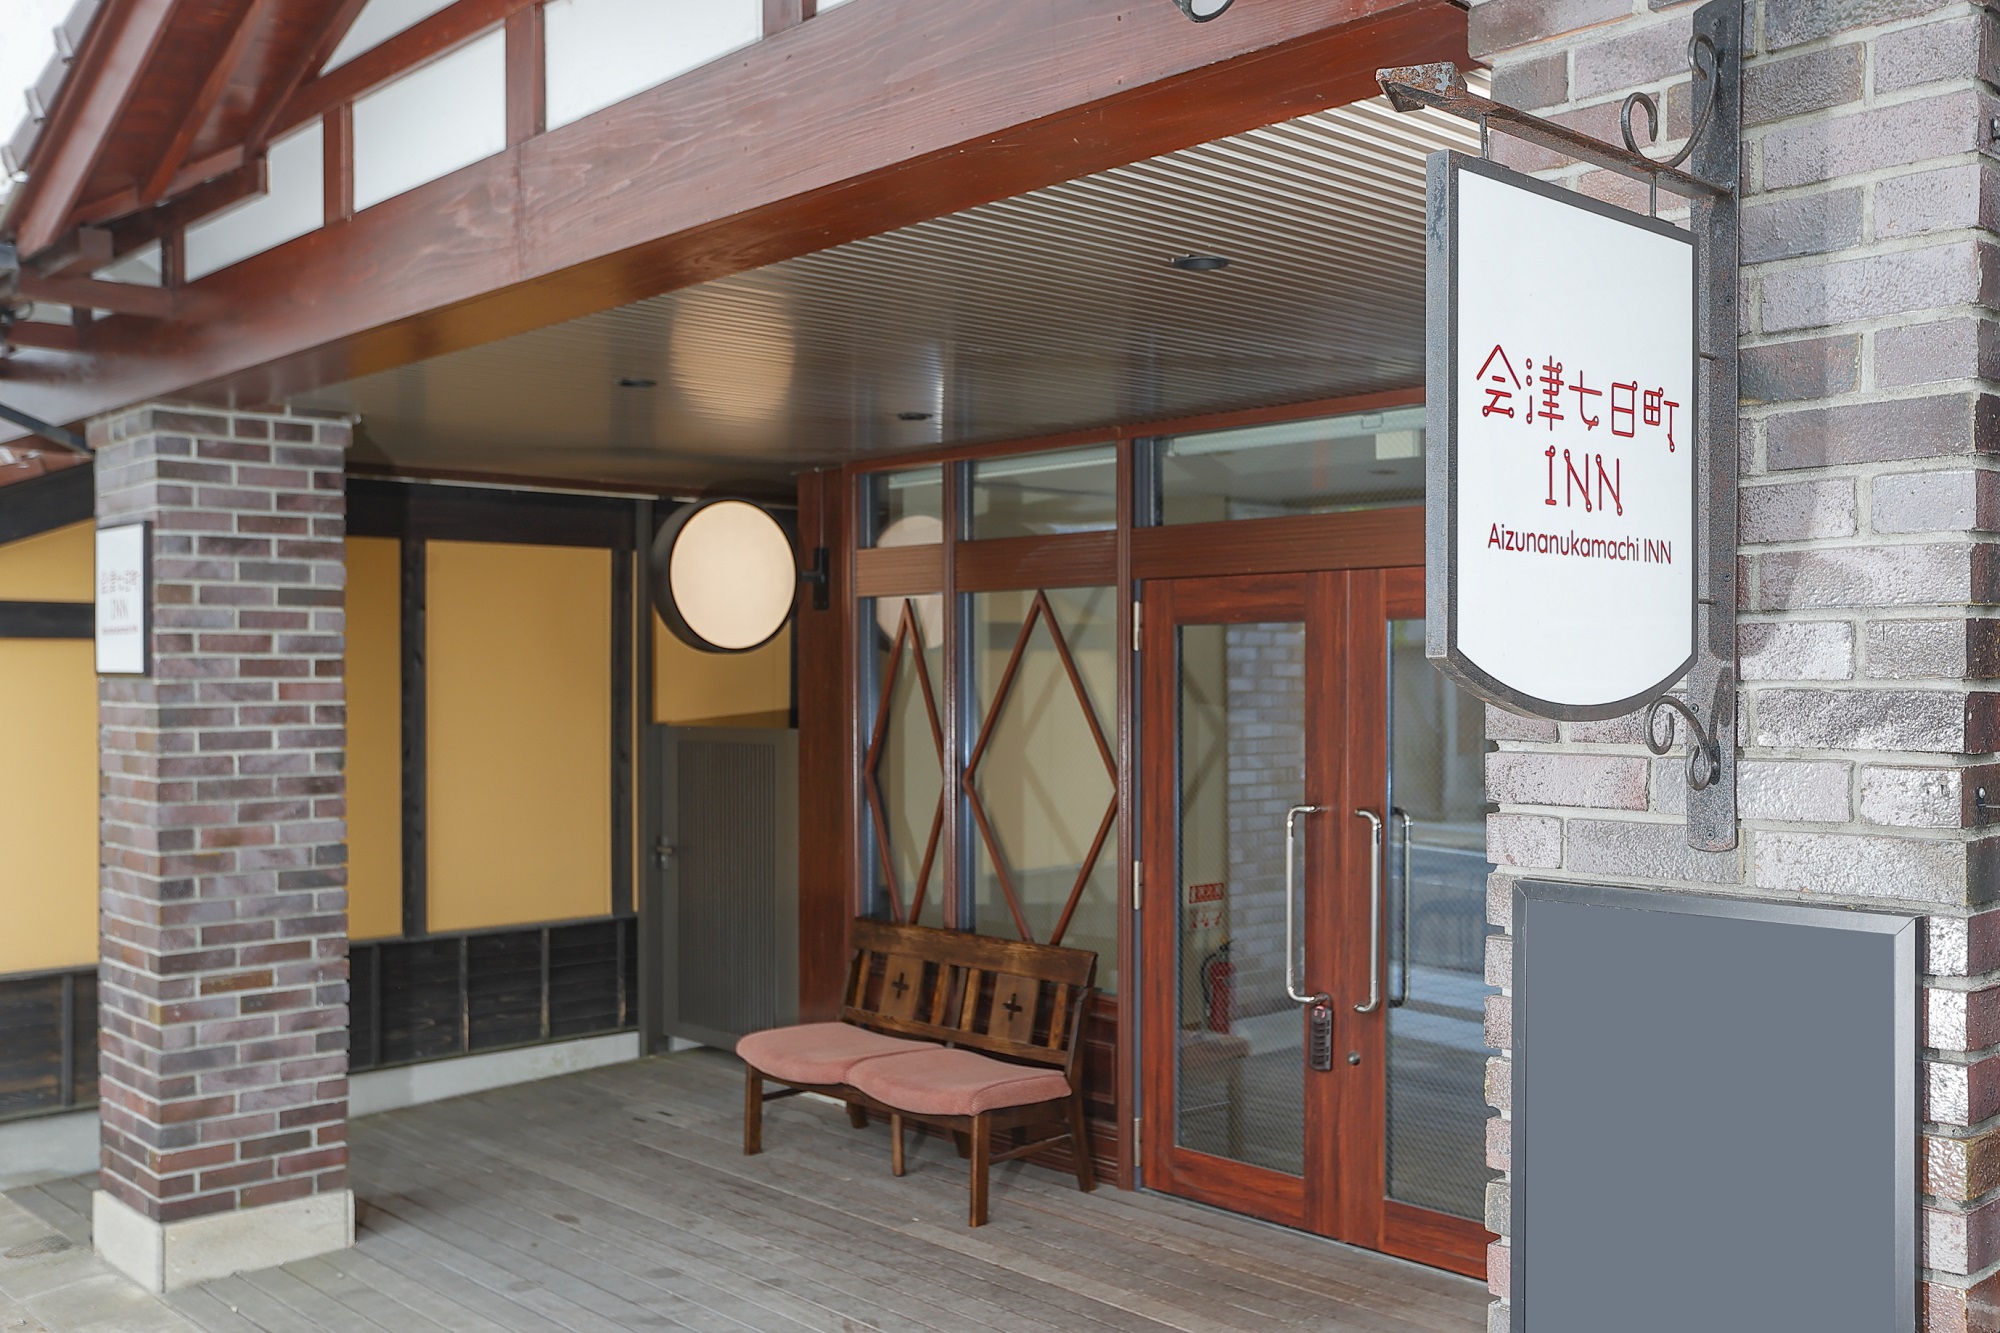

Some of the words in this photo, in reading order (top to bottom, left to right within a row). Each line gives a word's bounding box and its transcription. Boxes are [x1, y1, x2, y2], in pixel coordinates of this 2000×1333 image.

[1476, 344, 1680, 453] 会津七日町
[1544, 445, 1623, 516] INN
[1488, 522, 1639, 562] Aizunanukamachi
[1643, 538, 1672, 565] INN
